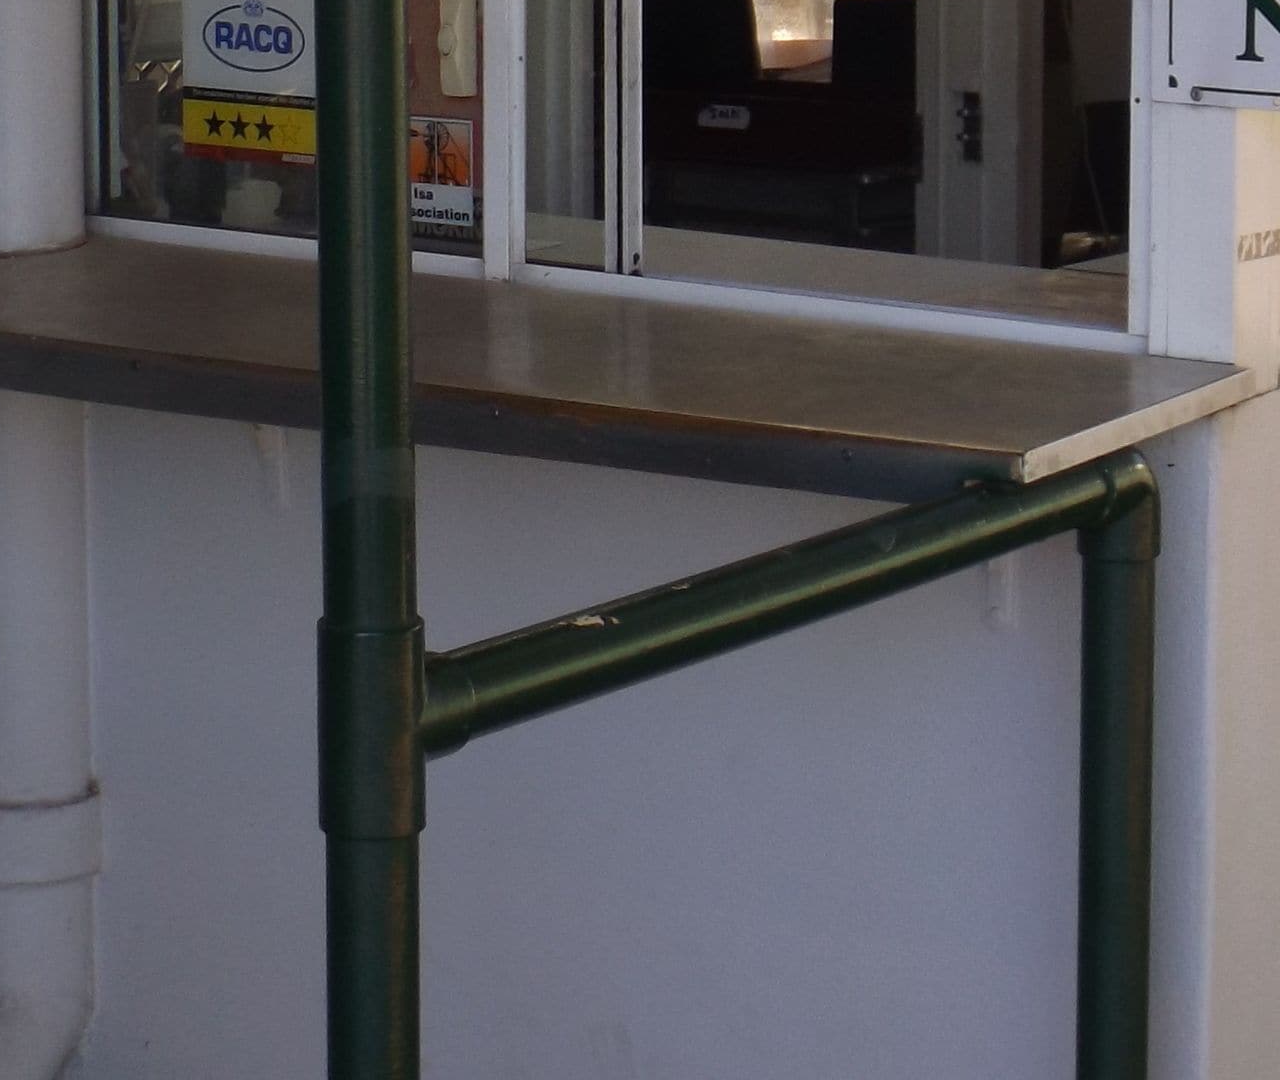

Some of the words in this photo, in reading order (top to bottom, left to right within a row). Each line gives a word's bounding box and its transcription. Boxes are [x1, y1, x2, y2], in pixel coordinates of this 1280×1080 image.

[215, 21, 293, 55] RACQ
[414, 187, 434, 200] Isa
[410, 206, 470, 222] sociation
